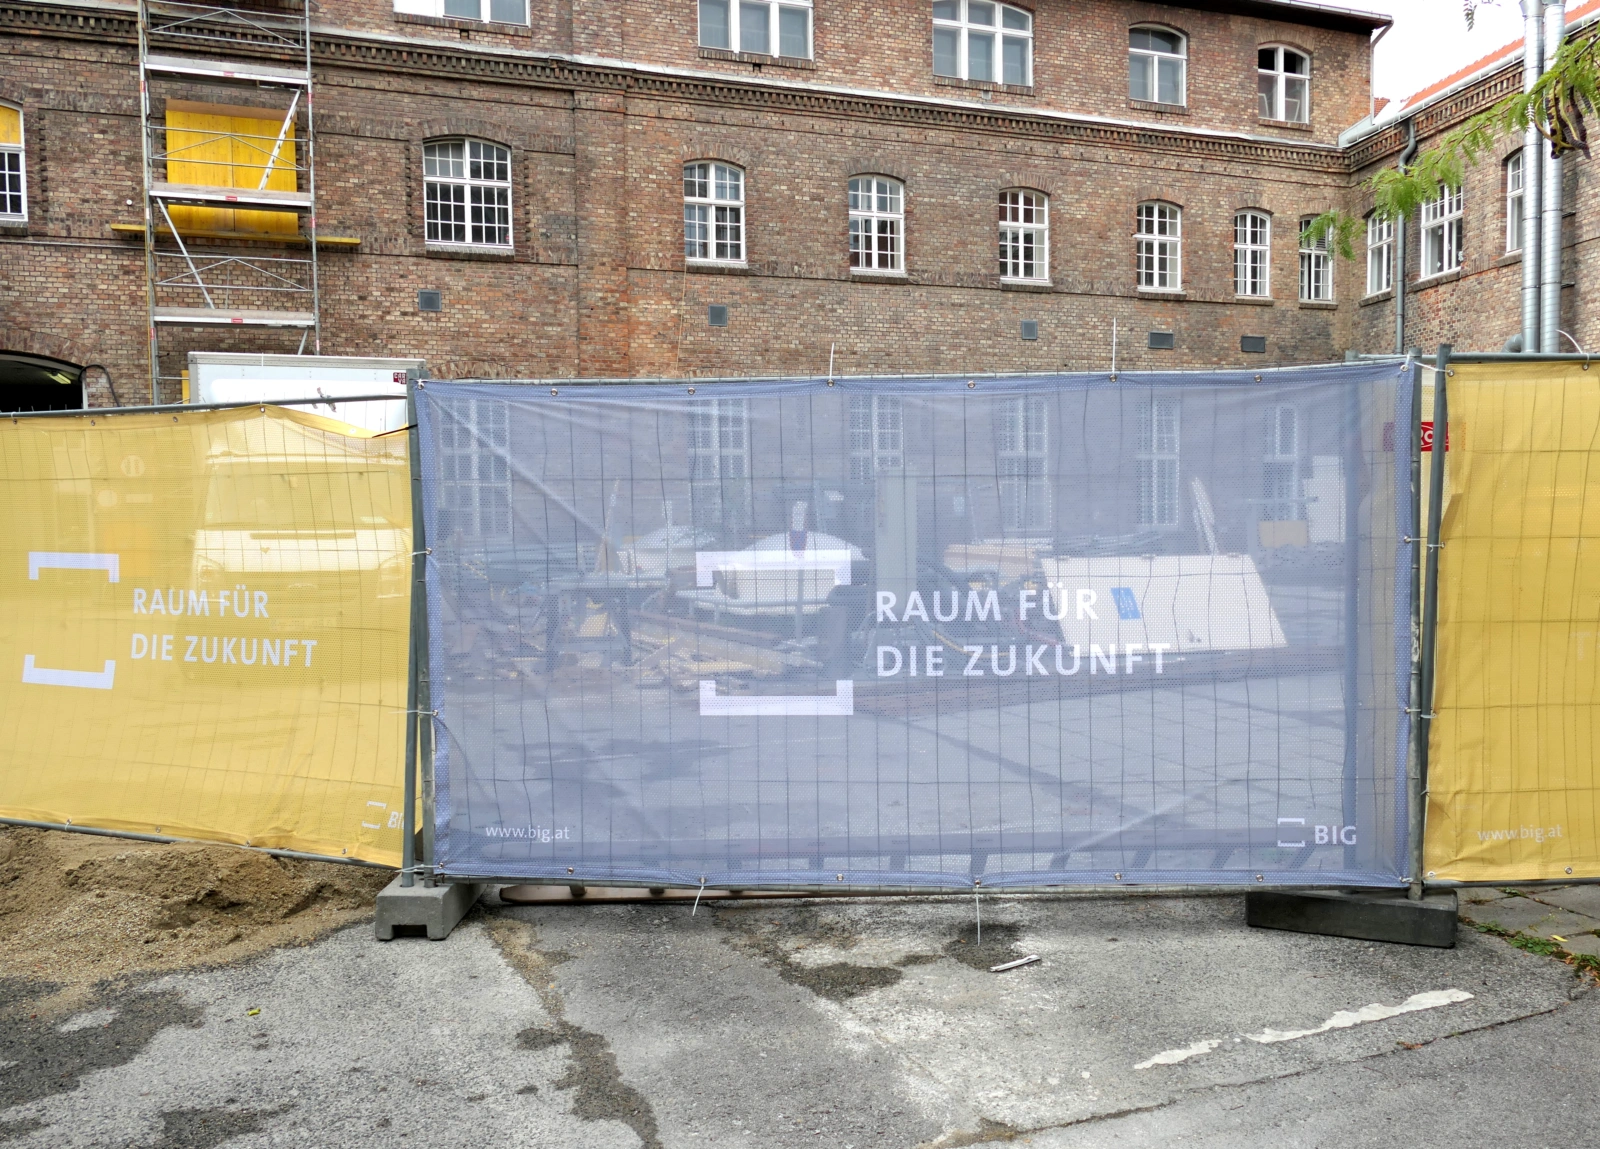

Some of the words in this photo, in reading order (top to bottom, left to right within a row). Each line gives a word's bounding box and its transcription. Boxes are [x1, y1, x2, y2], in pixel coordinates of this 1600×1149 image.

[133, 588, 210, 616] RAUM
[219, 585, 269, 618] FÜR
[876, 590, 1002, 622] RAUM
[1019, 582, 1099, 621] FÜR
[131, 633, 174, 661] DIE
[184, 635, 317, 667] ZUKUNFT
[877, 645, 944, 677] DIE
[963, 642, 1171, 677] ZUKUNFT
[387, 811, 405, 830] BI
[1477, 824, 1563, 843] www.big.at
[485, 825, 570, 843] www.big.at
[1314, 825, 1357, 845] BIG
